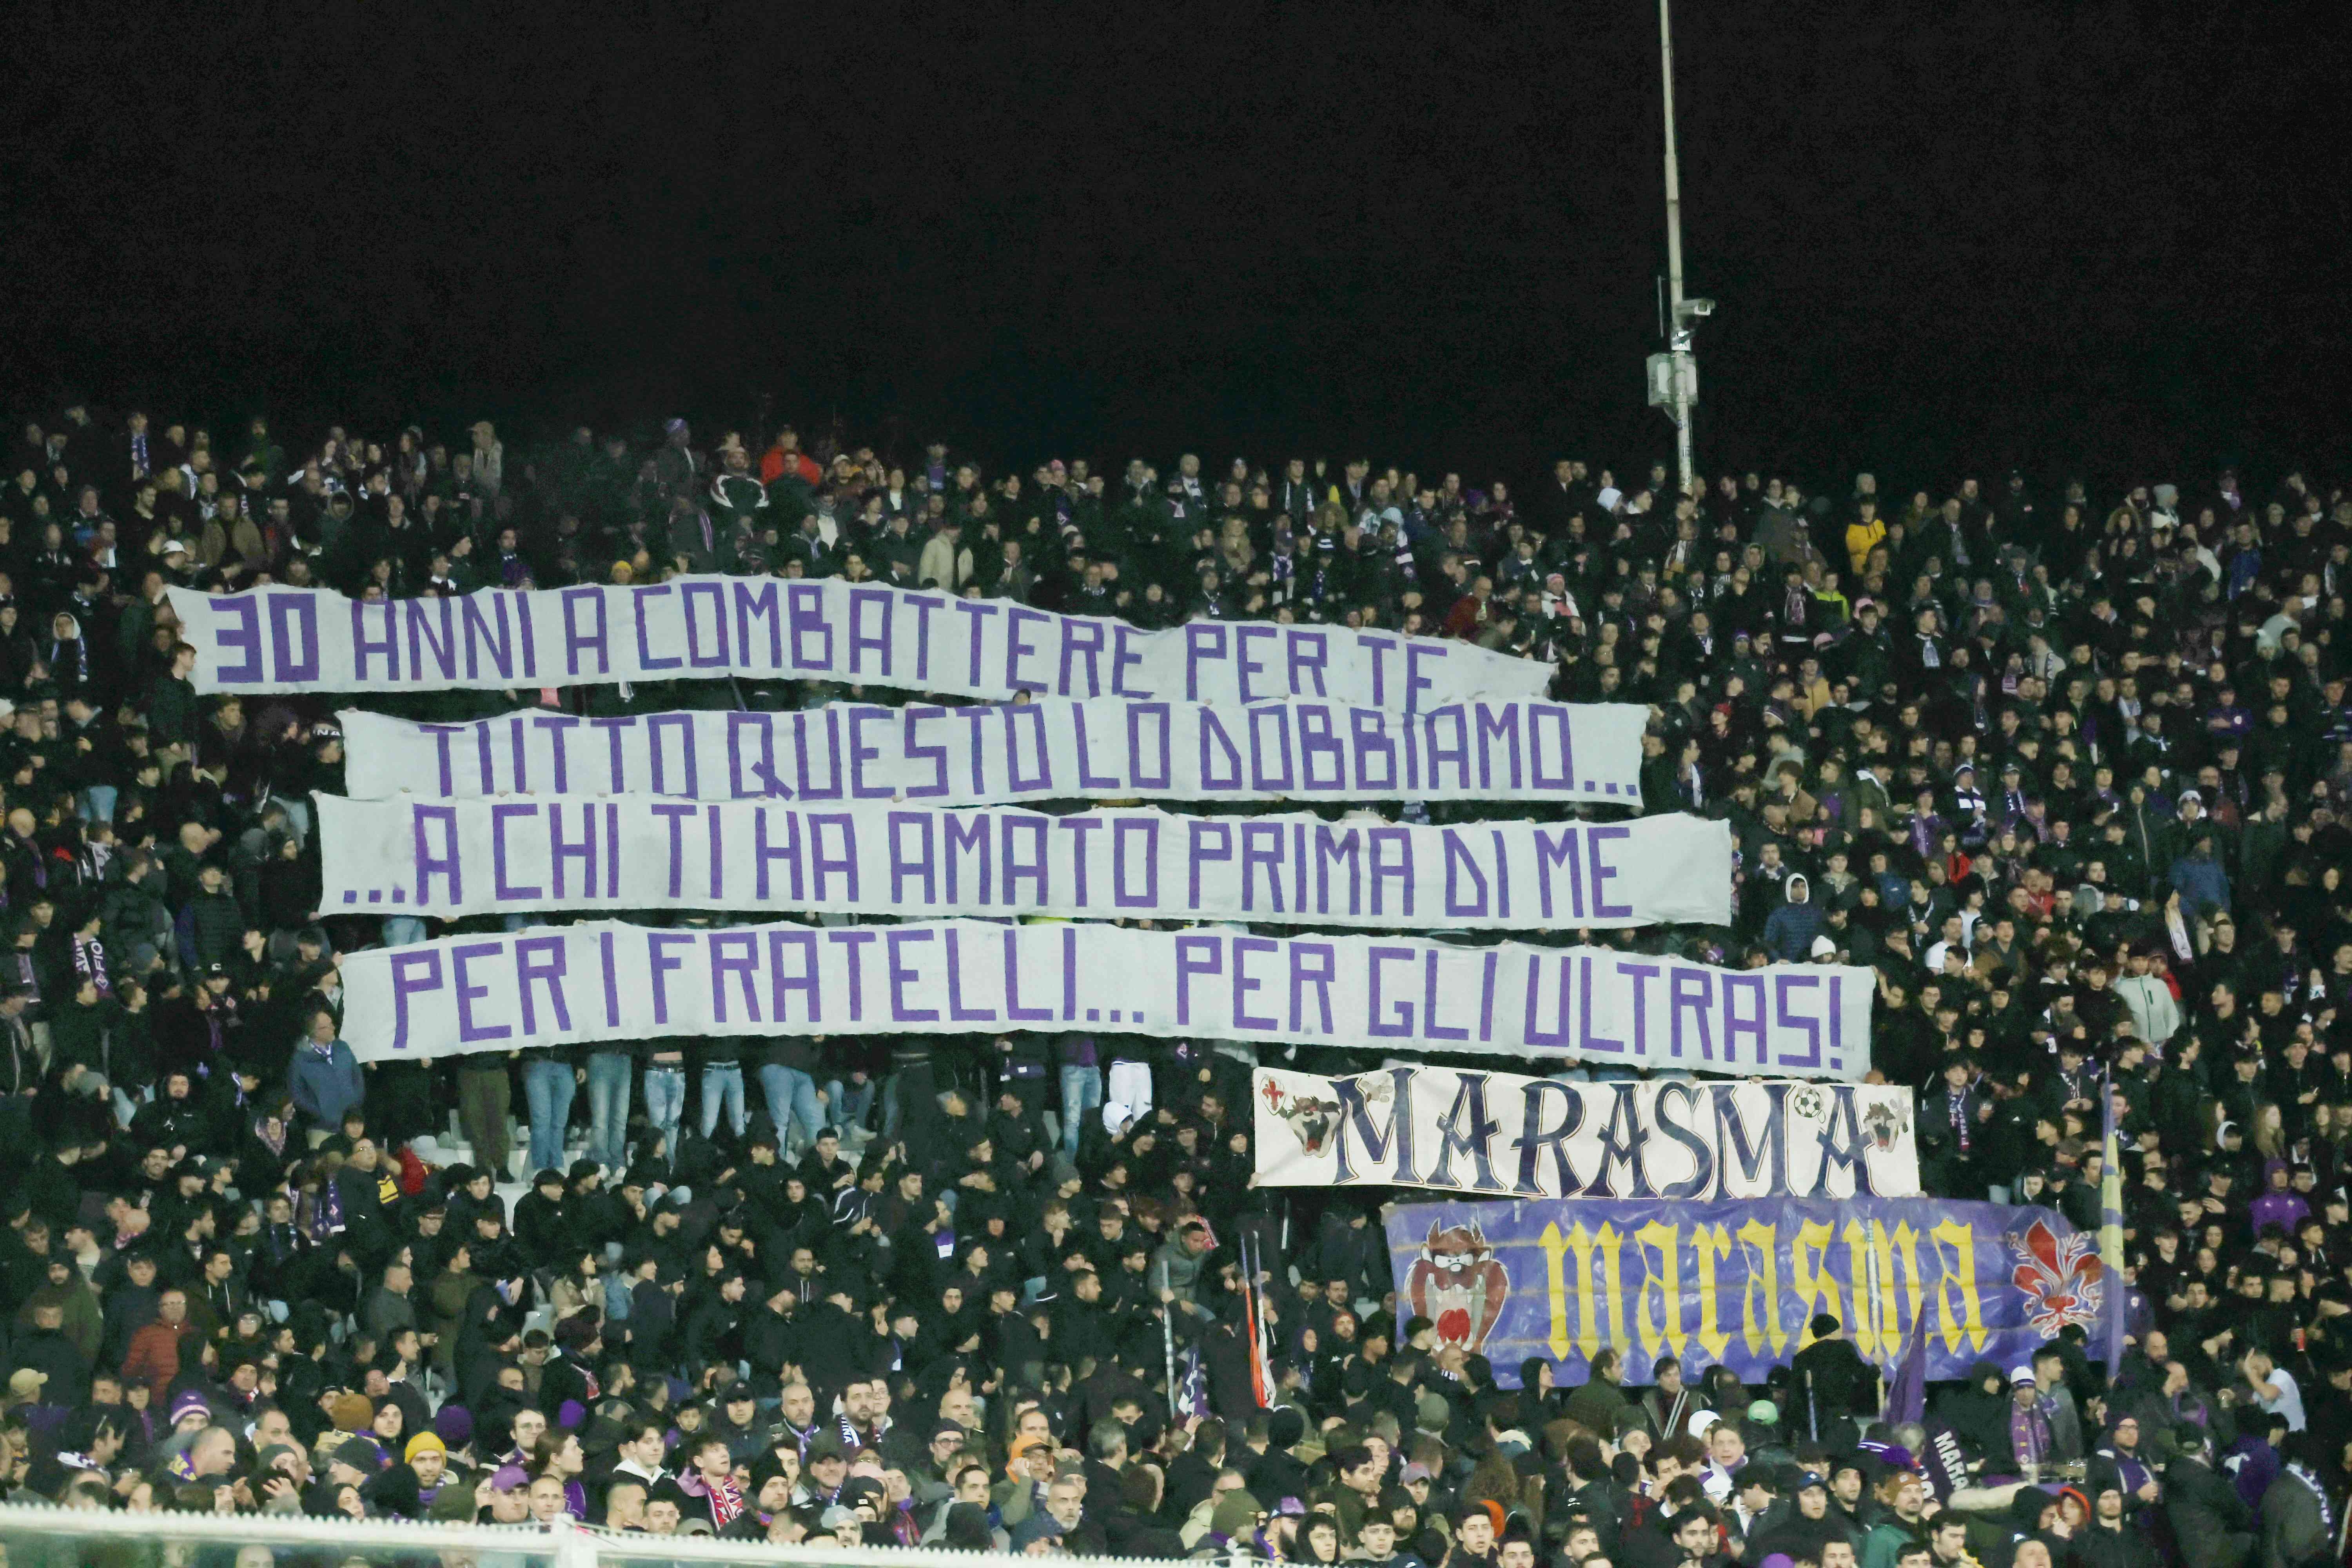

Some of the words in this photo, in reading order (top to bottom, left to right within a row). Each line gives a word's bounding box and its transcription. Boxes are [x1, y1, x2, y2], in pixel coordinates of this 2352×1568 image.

[209, 593, 319, 683] 30
[352, 592, 535, 680] ANNI
[563, 587, 609, 675] A
[633, 582, 1156, 699] COMBATTERE
[1185, 624, 1327, 703] PER
[1357, 635, 1447, 713] TE
[420, 713, 695, 798] TUTTO
[726, 704, 1053, 800] QUESTO
[1072, 702, 1170, 789] LO
[1200, 703, 1637, 797] DOBBIAMO...
[492, 803, 619, 900] CHI
[651, 804, 722, 899] TI
[756, 807, 858, 902] HA
[888, 811, 1159, 907] AMATO
[1189, 821, 1415, 916] PRIMA
[1442, 829, 1510, 918] DI
[1534, 827, 1632, 918] ME
[391, 936, 571, 1049] PER
[601, 932, 619, 1027] I
[648, 928, 1144, 1024] FRATELLI...
[1176, 936, 1335, 1034] PER
[1368, 947, 1498, 1042] GLI
[1524, 955, 1842, 1069] ULTRAS!
[1328, 1067, 1880, 1201] MARASMA
